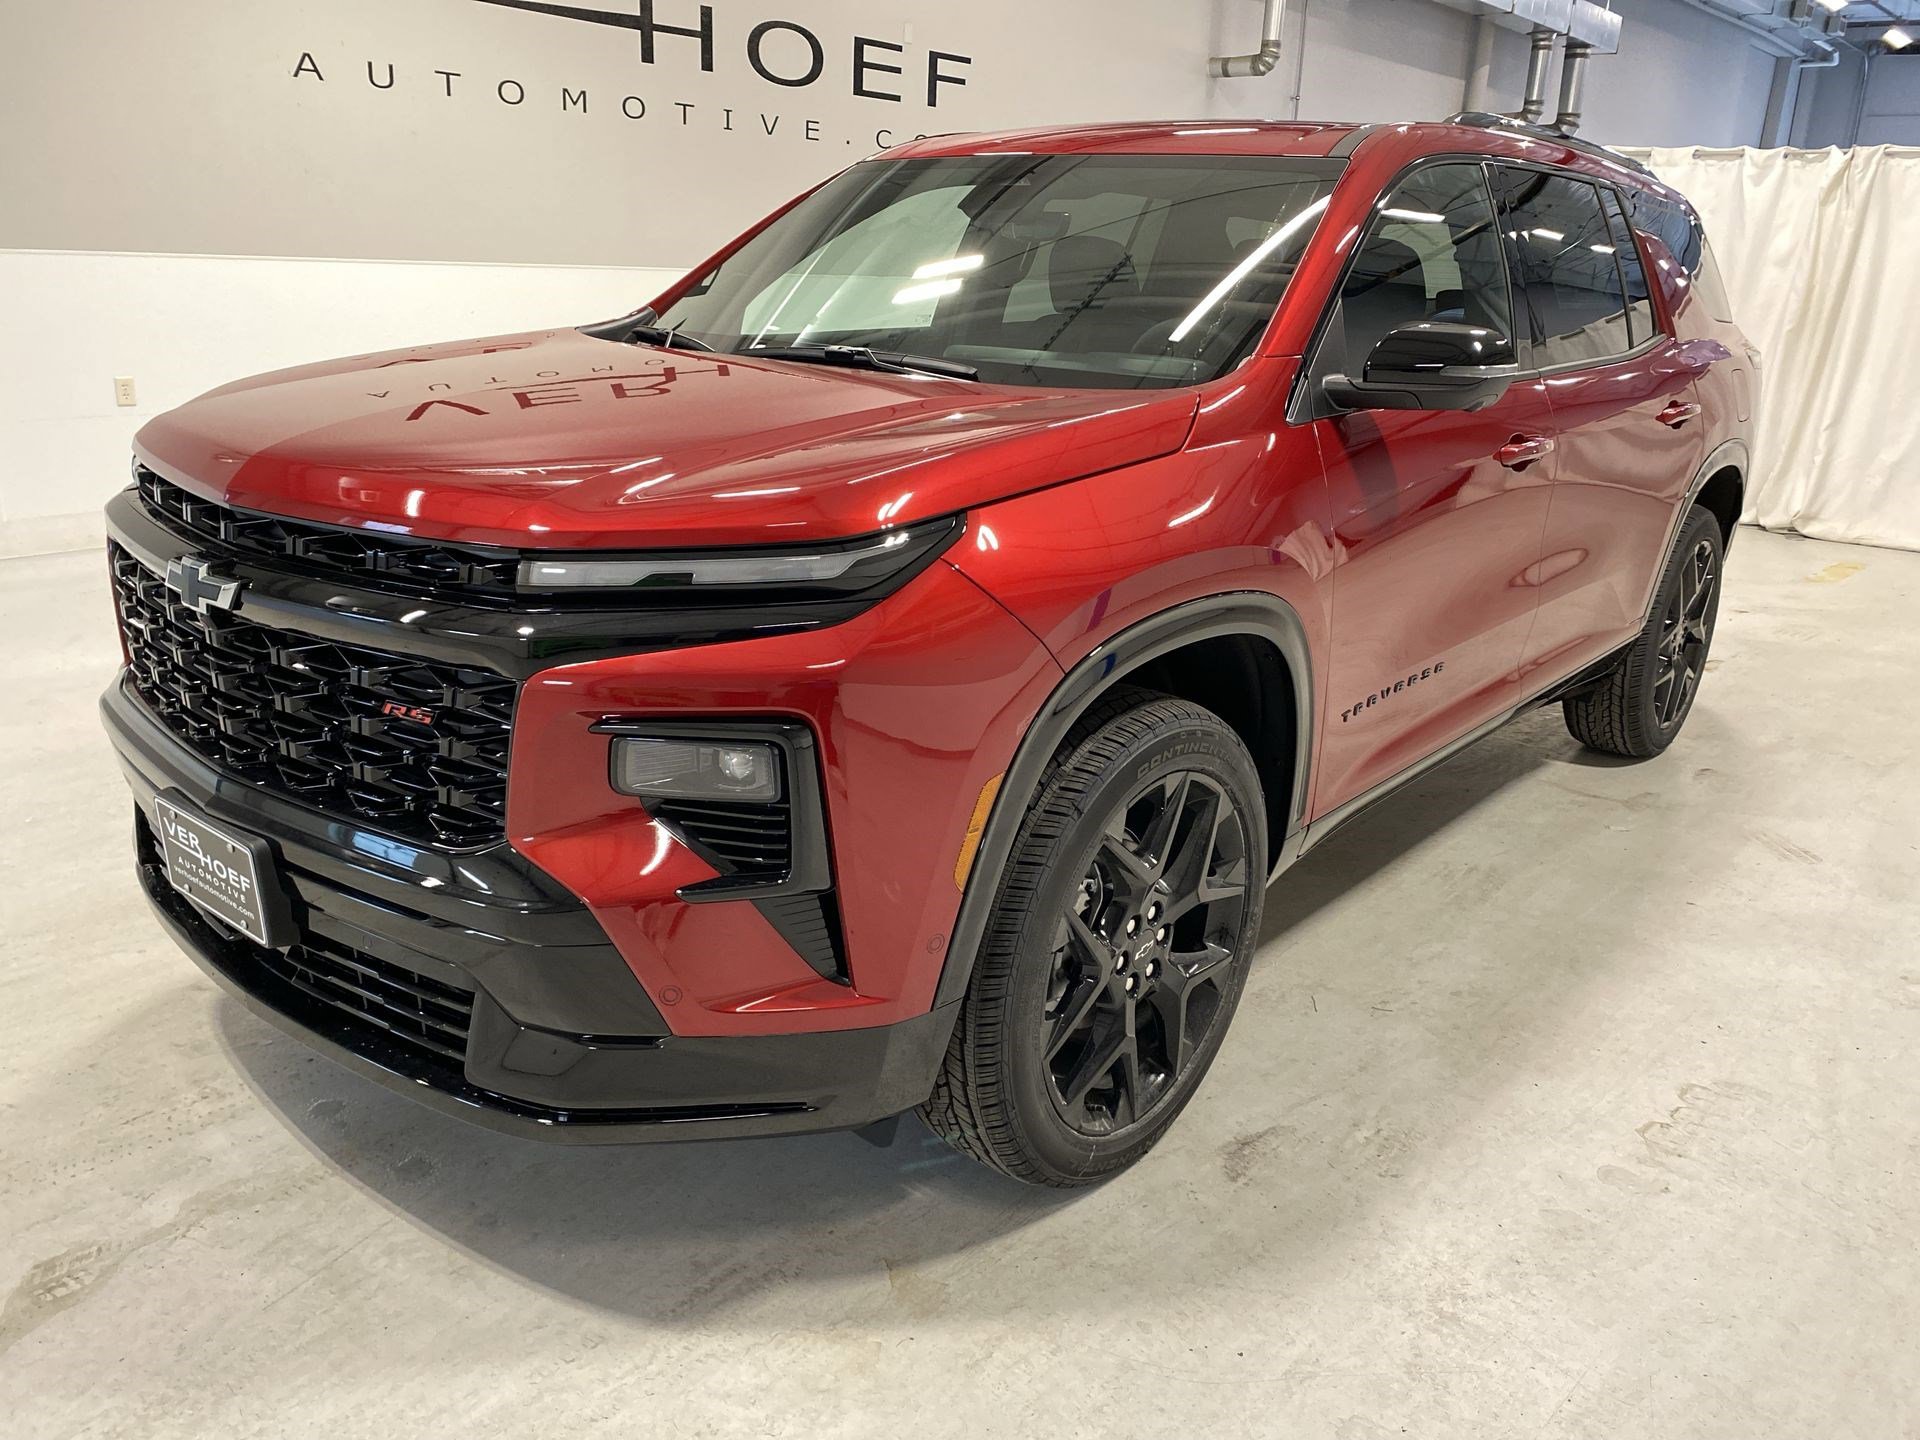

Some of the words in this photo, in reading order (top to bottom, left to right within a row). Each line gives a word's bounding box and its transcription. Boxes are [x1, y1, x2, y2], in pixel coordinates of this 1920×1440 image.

[639, 0, 972, 107] HOEF
[383, 702, 434, 725] RS
[1340, 661, 1445, 723] TRAVERSE
[1137, 741, 1237, 781] CONTINENTA
[173, 865, 255, 920] verhoefautomotive.com
[178, 856, 247, 904] AUTOMOTIVE
